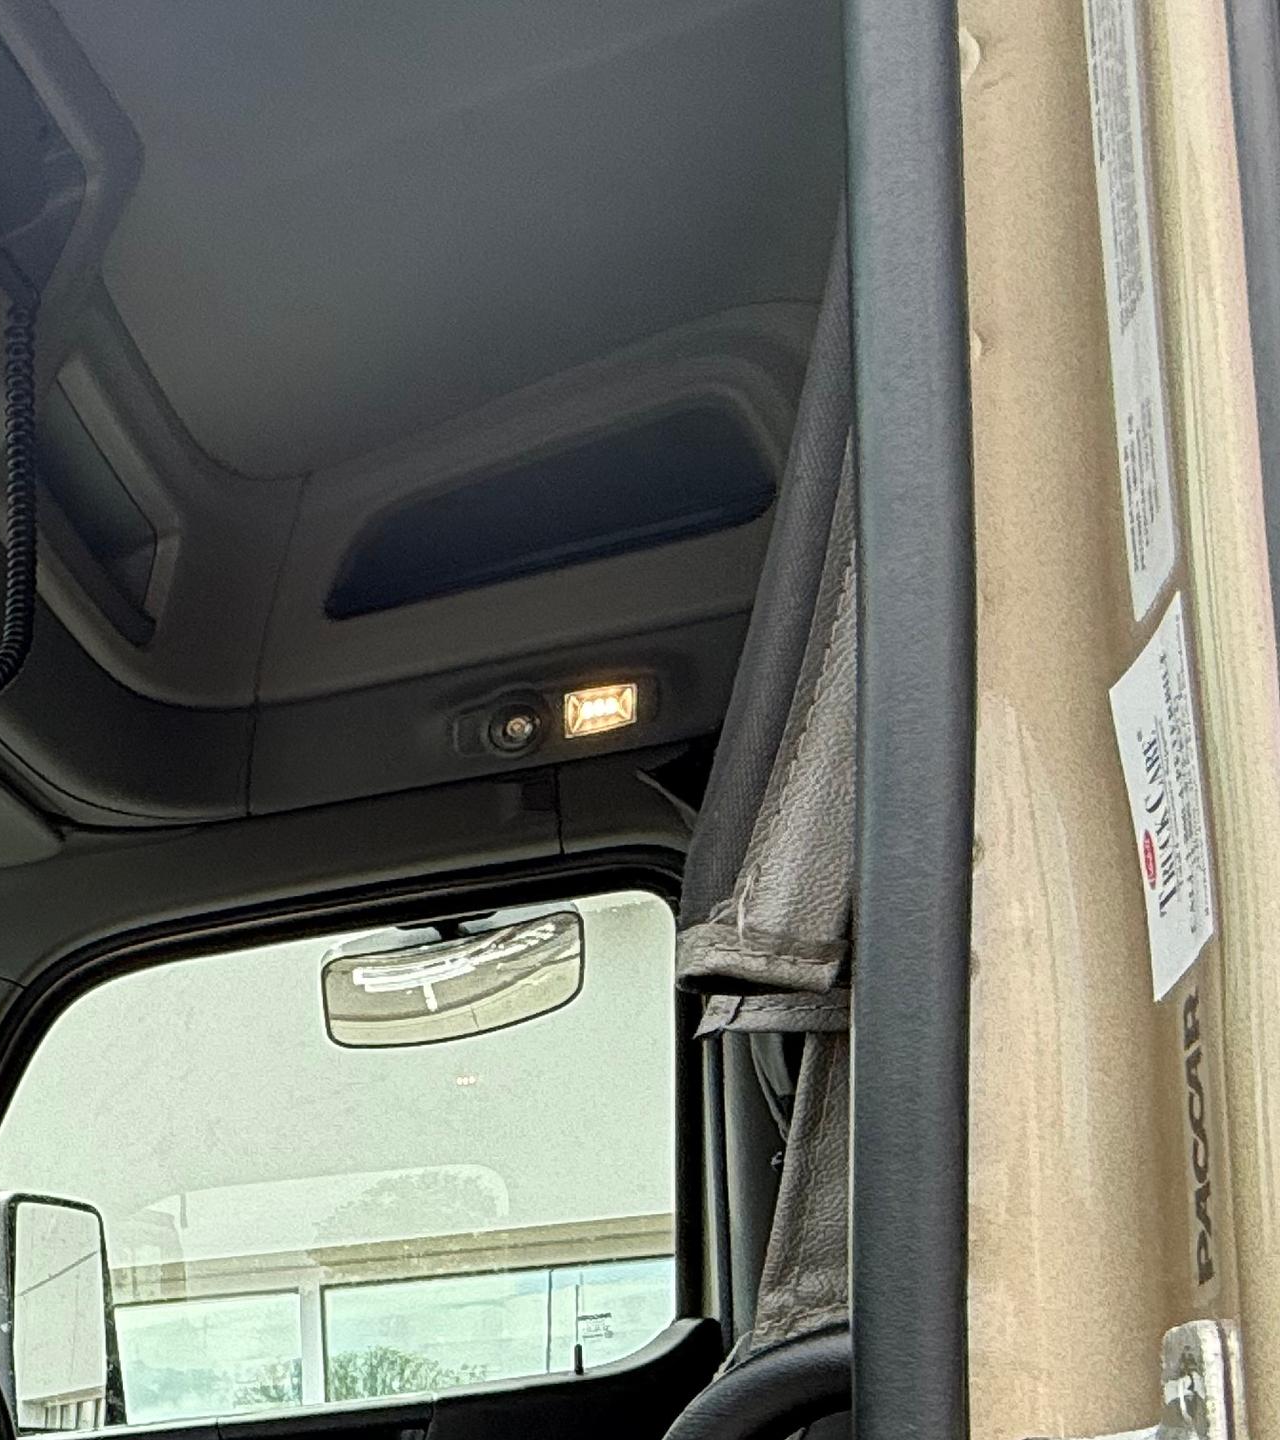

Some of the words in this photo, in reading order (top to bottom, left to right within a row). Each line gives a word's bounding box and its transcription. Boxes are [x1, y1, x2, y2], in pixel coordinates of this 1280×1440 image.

[1142, 735, 1165, 814] CARE
[1155, 807, 1178, 917] TRUCK
[1183, 985, 1216, 1287] PACCAR
